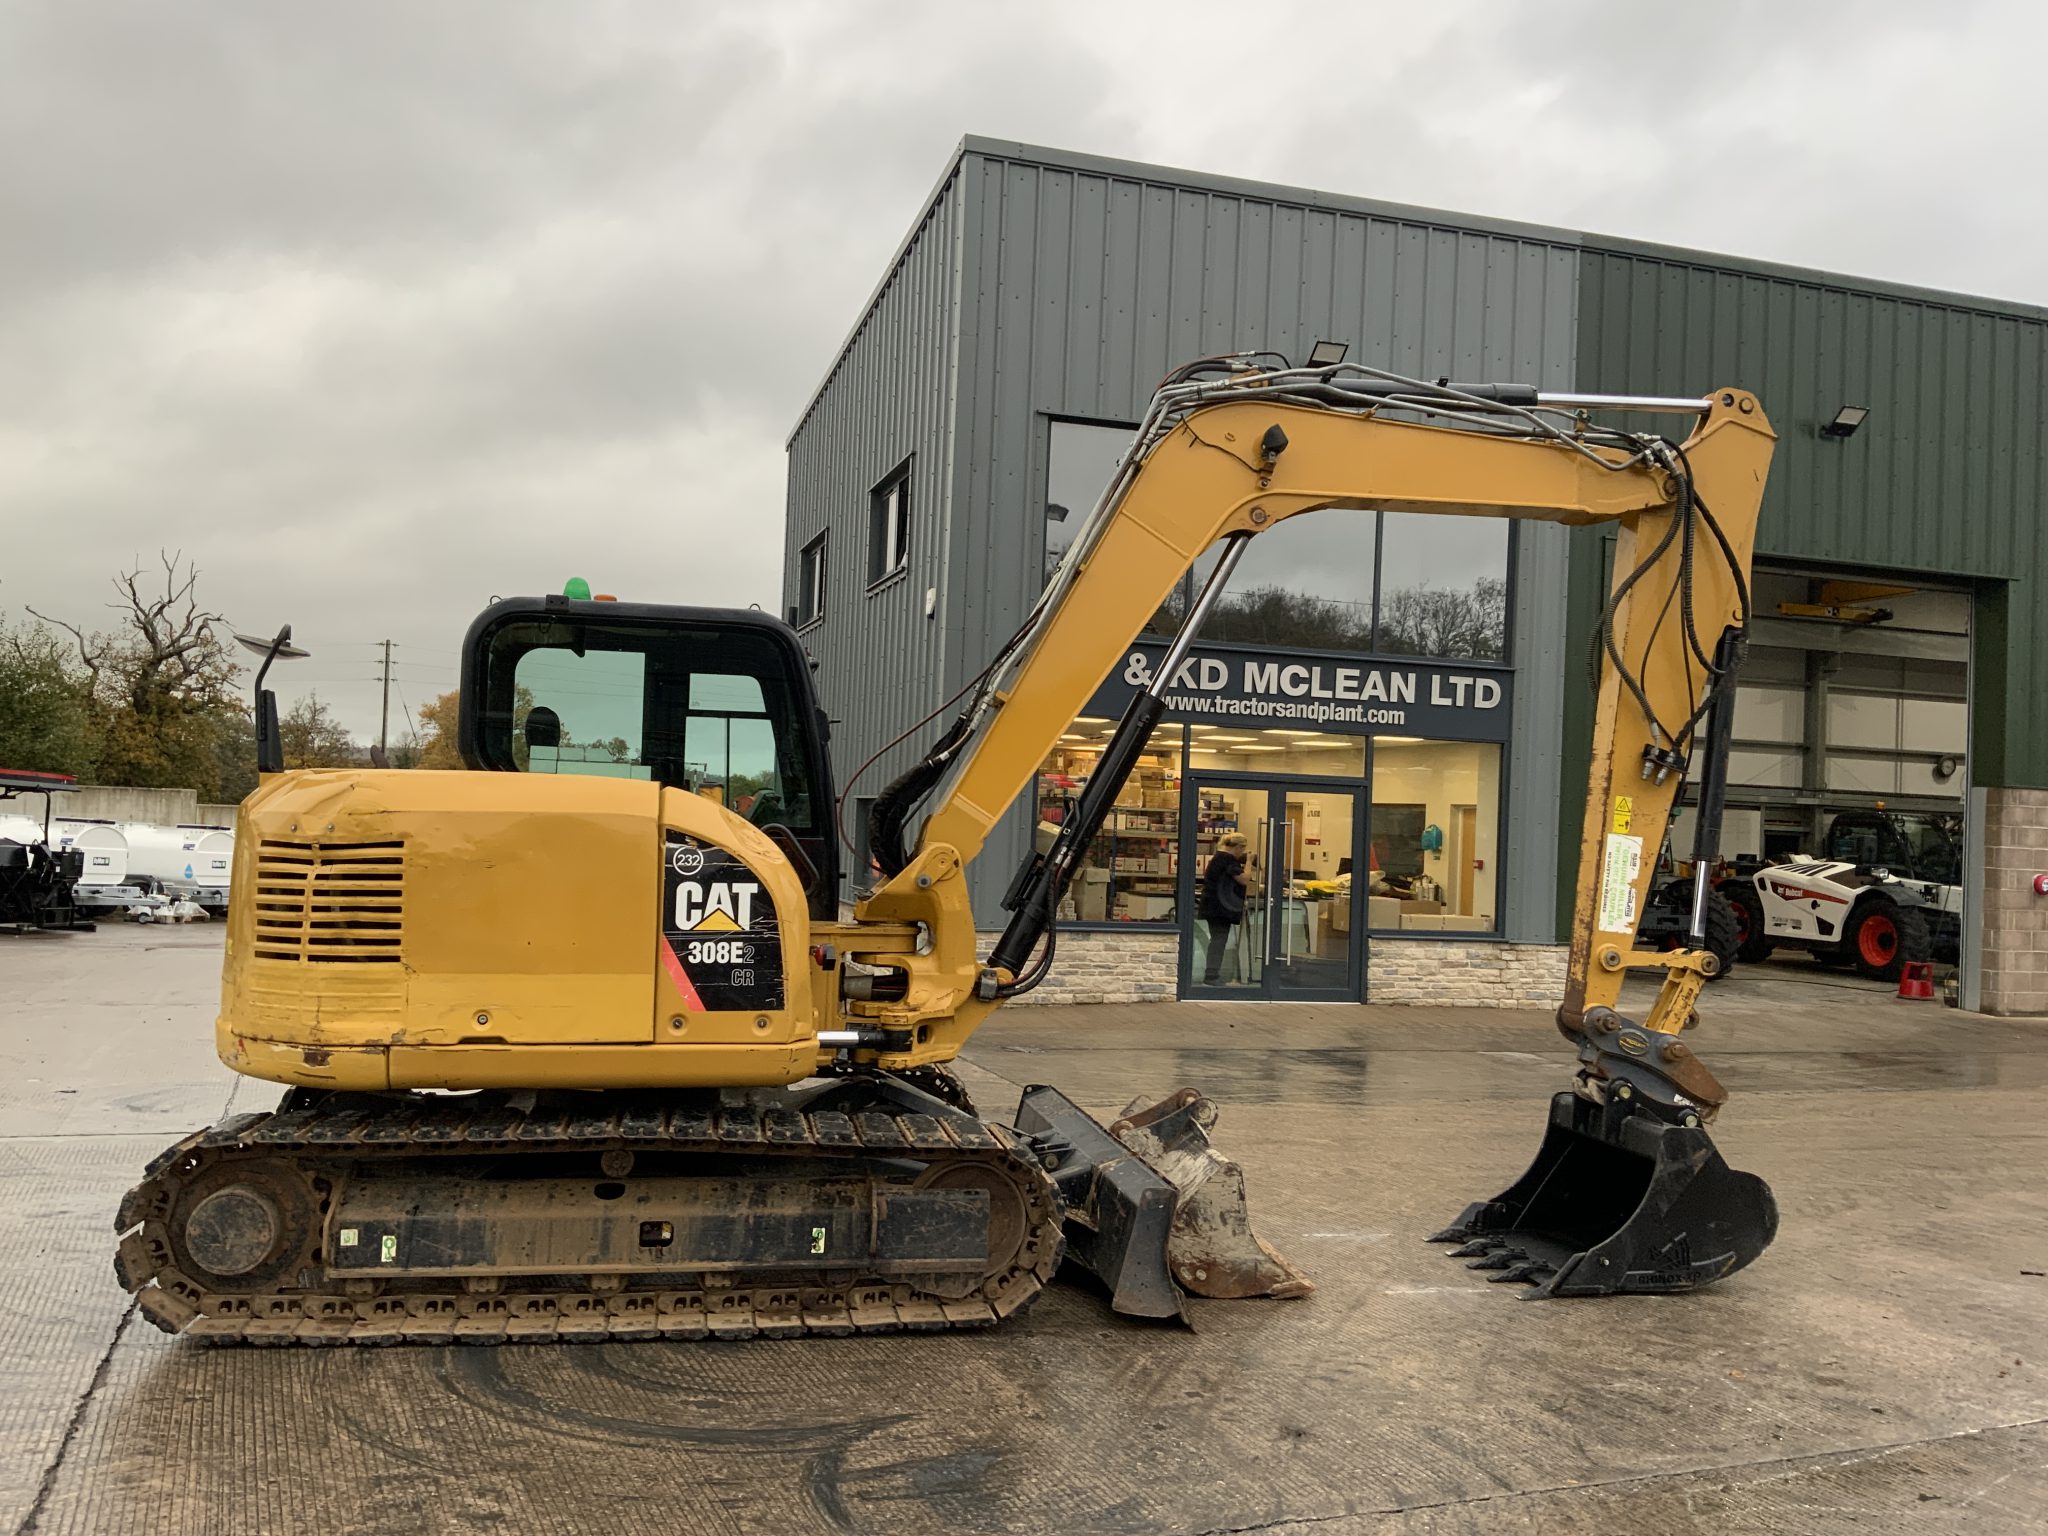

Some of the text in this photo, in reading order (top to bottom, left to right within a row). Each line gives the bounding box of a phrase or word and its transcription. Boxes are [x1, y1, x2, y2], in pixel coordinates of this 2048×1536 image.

[1124, 652, 1502, 709] & KD MCLEAN LTD
[1163, 695, 1405, 725] www.tractorsandplant.com
[677, 854, 701, 866] 232
[675, 881, 758, 931] CAT
[688, 941, 754, 964] 308E2
[731, 969, 754, 986] CR
